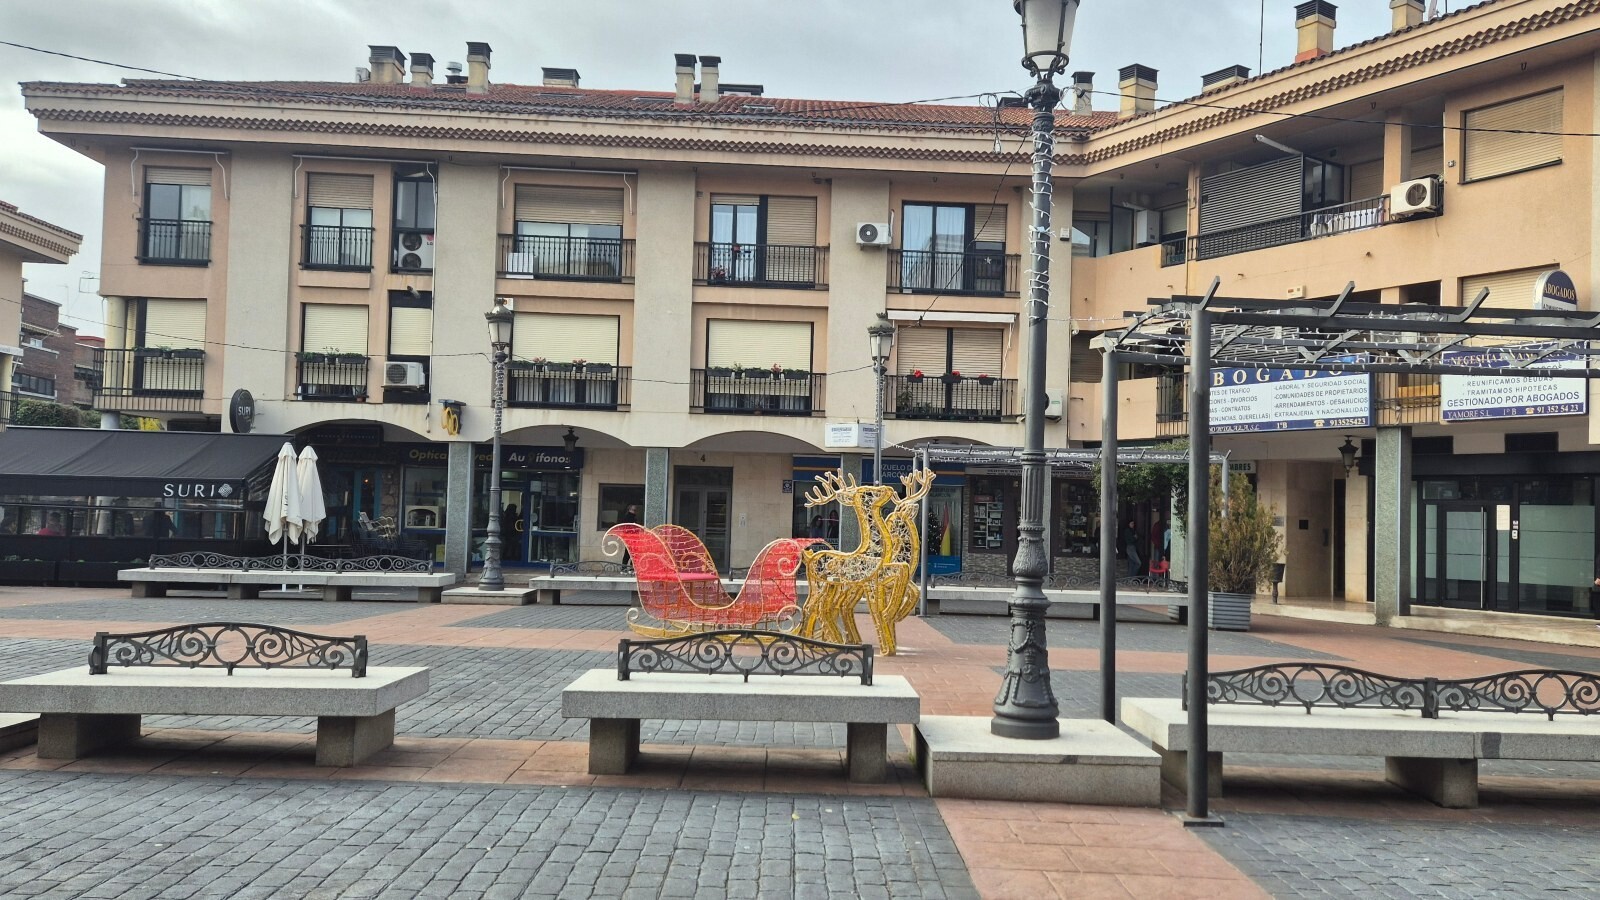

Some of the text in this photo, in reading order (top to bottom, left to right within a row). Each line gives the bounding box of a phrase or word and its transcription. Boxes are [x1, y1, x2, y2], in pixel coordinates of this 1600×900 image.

[1544, 282, 1575, 300] ABOGADOS
[1307, 380, 1342, 388] SEGURIDAD
[1466, 378, 1520, 386] REUNIFICAMOS
[1325, 388, 1367, 396] PROPIETARIOS
[1467, 384, 1558, 396] TRAMITAMOS HIPOTECAS
[1330, 397, 1368, 405] DESAHUCIOS
[1447, 392, 1580, 407] GESTIONADO POR ABOGADOS
[238, 406, 251, 416] SURI
[1322, 407, 1368, 415] NACIONALIDAD
[1330, 418, 1366, 426] 913525423
[700, 454, 706, 462] 4
[163, 484, 214, 497] SURI
